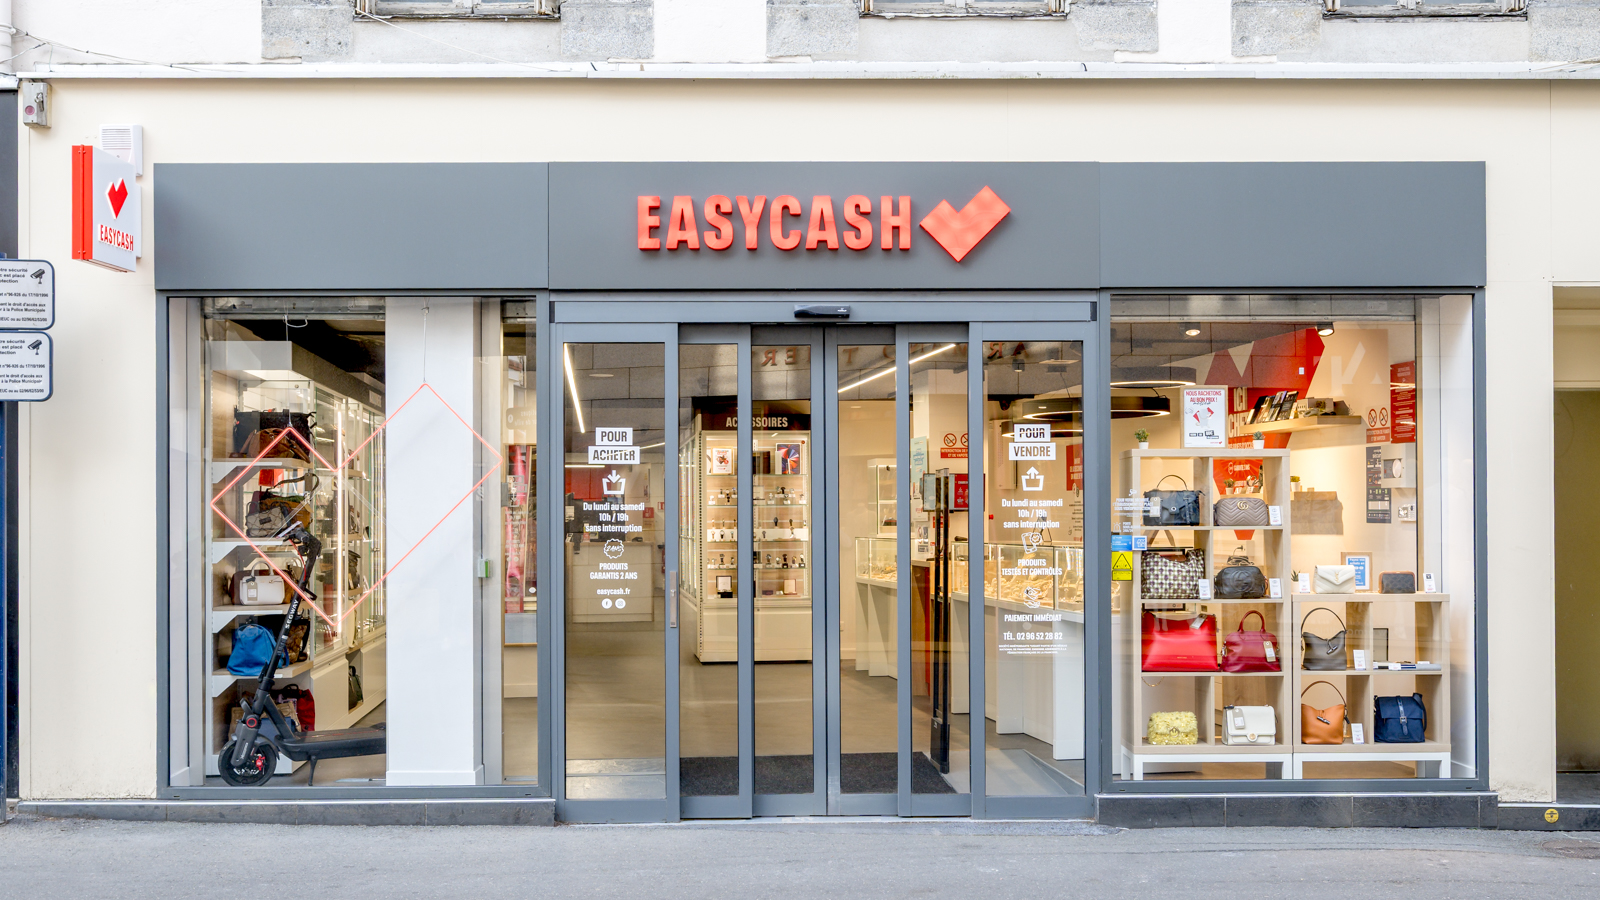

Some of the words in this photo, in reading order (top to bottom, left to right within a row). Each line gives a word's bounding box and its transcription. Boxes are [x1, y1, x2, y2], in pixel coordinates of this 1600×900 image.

[637, 195, 911, 250] EASYCASH
[99, 224, 134, 251] EASYCASH
[726, 417, 788, 427] ACSSOIRES
[601, 431, 627, 442] POUR
[1019, 428, 1045, 438] POUR
[593, 450, 635, 460] ACHETER
[1014, 446, 1051, 457] VENDRE
[1002, 499, 1011, 507] Du
[1012, 499, 1028, 507] lundi
[1039, 499, 1063, 507] samedi
[599, 513, 611, 521] 10h
[617, 513, 629, 521] 19h
[1018, 509, 1029, 518] 10h
[1036, 509, 1047, 518] 19h
[602, 524, 642, 533] interruption
[1020, 520, 1060, 529] interruption
[1002, 567, 1021, 575] TESTÉS
[1029, 567, 1062, 575] CONTRÔLÉS
[285, 600, 299, 629] SEGWAY
[1034, 613, 1062, 622] IMMÉDIAT
[1003, 631, 1015, 640] TÉL.
